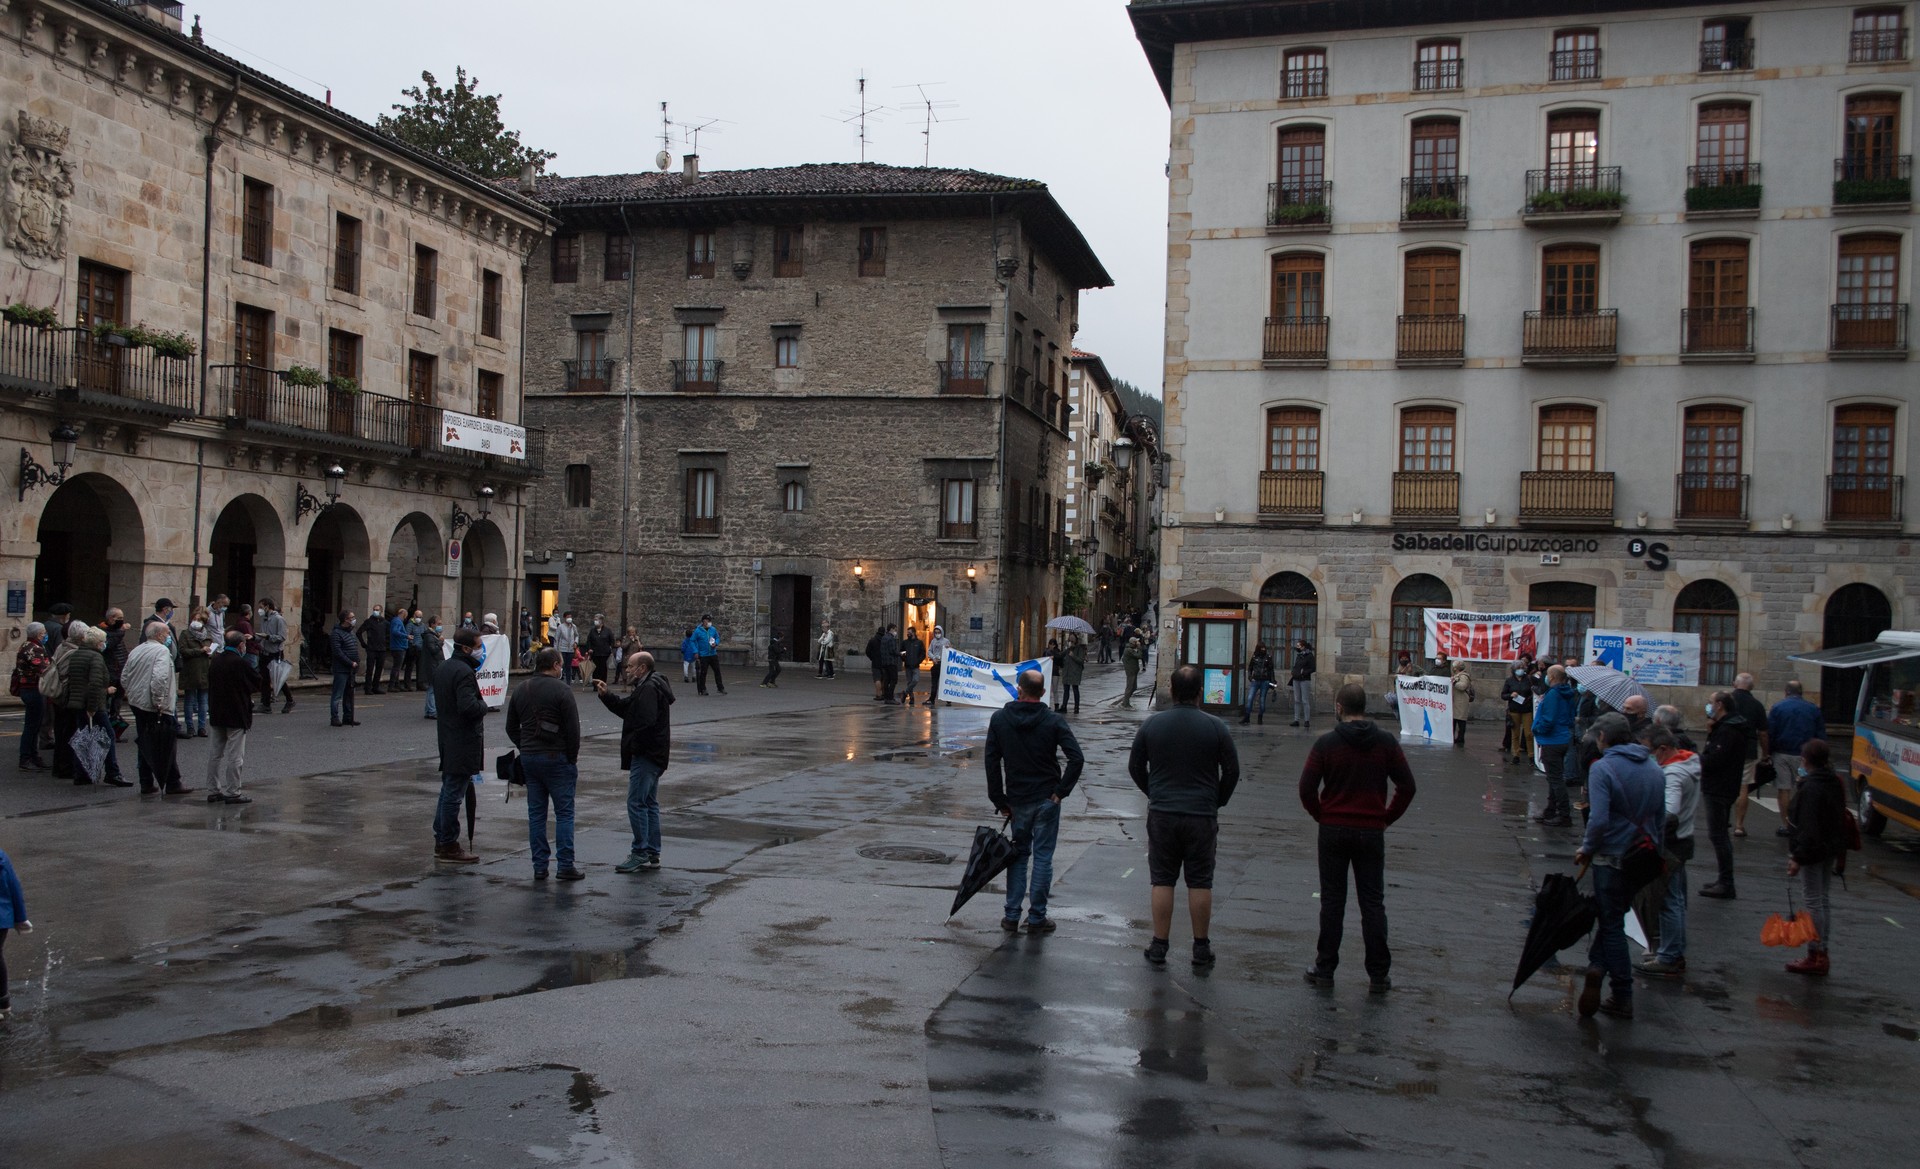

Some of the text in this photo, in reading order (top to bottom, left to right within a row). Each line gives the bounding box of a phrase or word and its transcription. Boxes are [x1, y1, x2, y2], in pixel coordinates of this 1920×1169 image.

[1436, 621, 1537, 661] ERAILA
[1593, 637, 1623, 648] etxera
[946, 665, 973, 678] umeak
